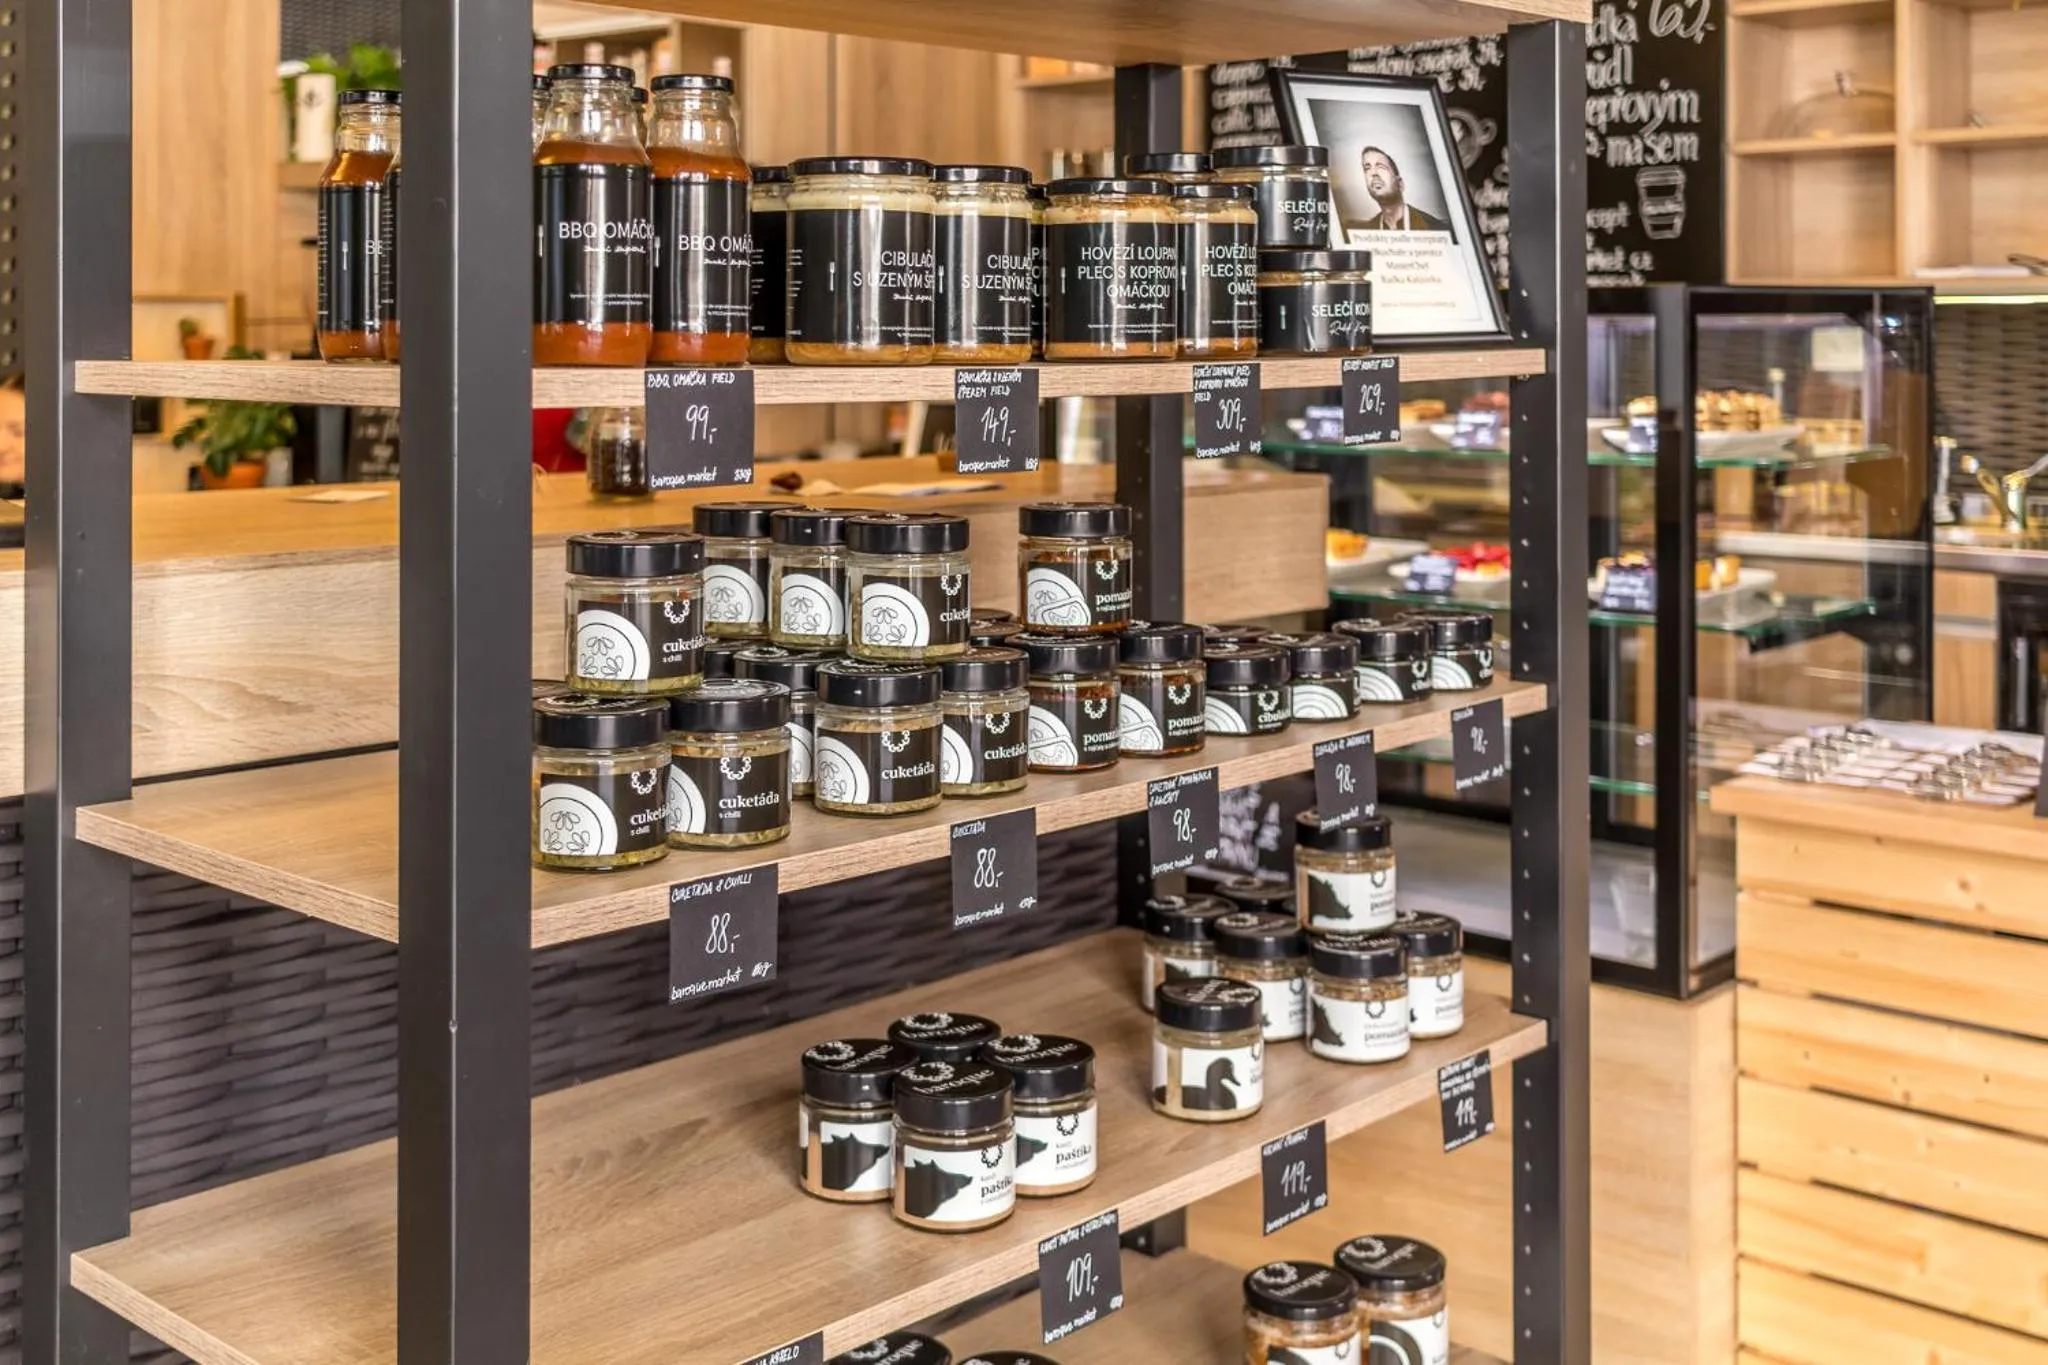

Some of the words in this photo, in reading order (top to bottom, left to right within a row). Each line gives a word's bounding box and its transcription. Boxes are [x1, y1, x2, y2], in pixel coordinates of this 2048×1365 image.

[559, 221, 598, 240] BBQ
[679, 234, 716, 252] BBQ
[1081, 243, 1135, 261] HOVĚZÍ
[1205, 242, 1247, 259] HOVĚZÍ
[852, 271, 863, 288] S
[962, 275, 973, 290] S
[976, 271, 1025, 290] UZENÝM
[1077, 264, 1114, 281] PLEC
[1118, 265, 1127, 280] S
[1201, 263, 1234, 278] PLEC
[1236, 263, 1243, 278] S
[1106, 281, 1171, 299] OMÁČKOU
[647, 372, 671, 388] BBQ
[711, 371, 736, 385] FIELD
[1359, 383, 1386, 416] 269,-
[686, 404, 718, 446] 99,-
[1216, 397, 1247, 434] 309,-
[981, 405, 1017, 448] 149,-
[881, 760, 935, 780] cuketáda
[1335, 763, 1356, 794] 98,-
[718, 790, 781, 810] cuketáda
[1173, 807, 1198, 843] 98,-
[974, 847, 1005, 889] 88,-
[705, 912, 741, 954] 88,-
[912, 1069, 996, 1095] baroque
[1281, 1160, 1312, 1197] 119,-
[1066, 1251, 1100, 1303] 109,-
